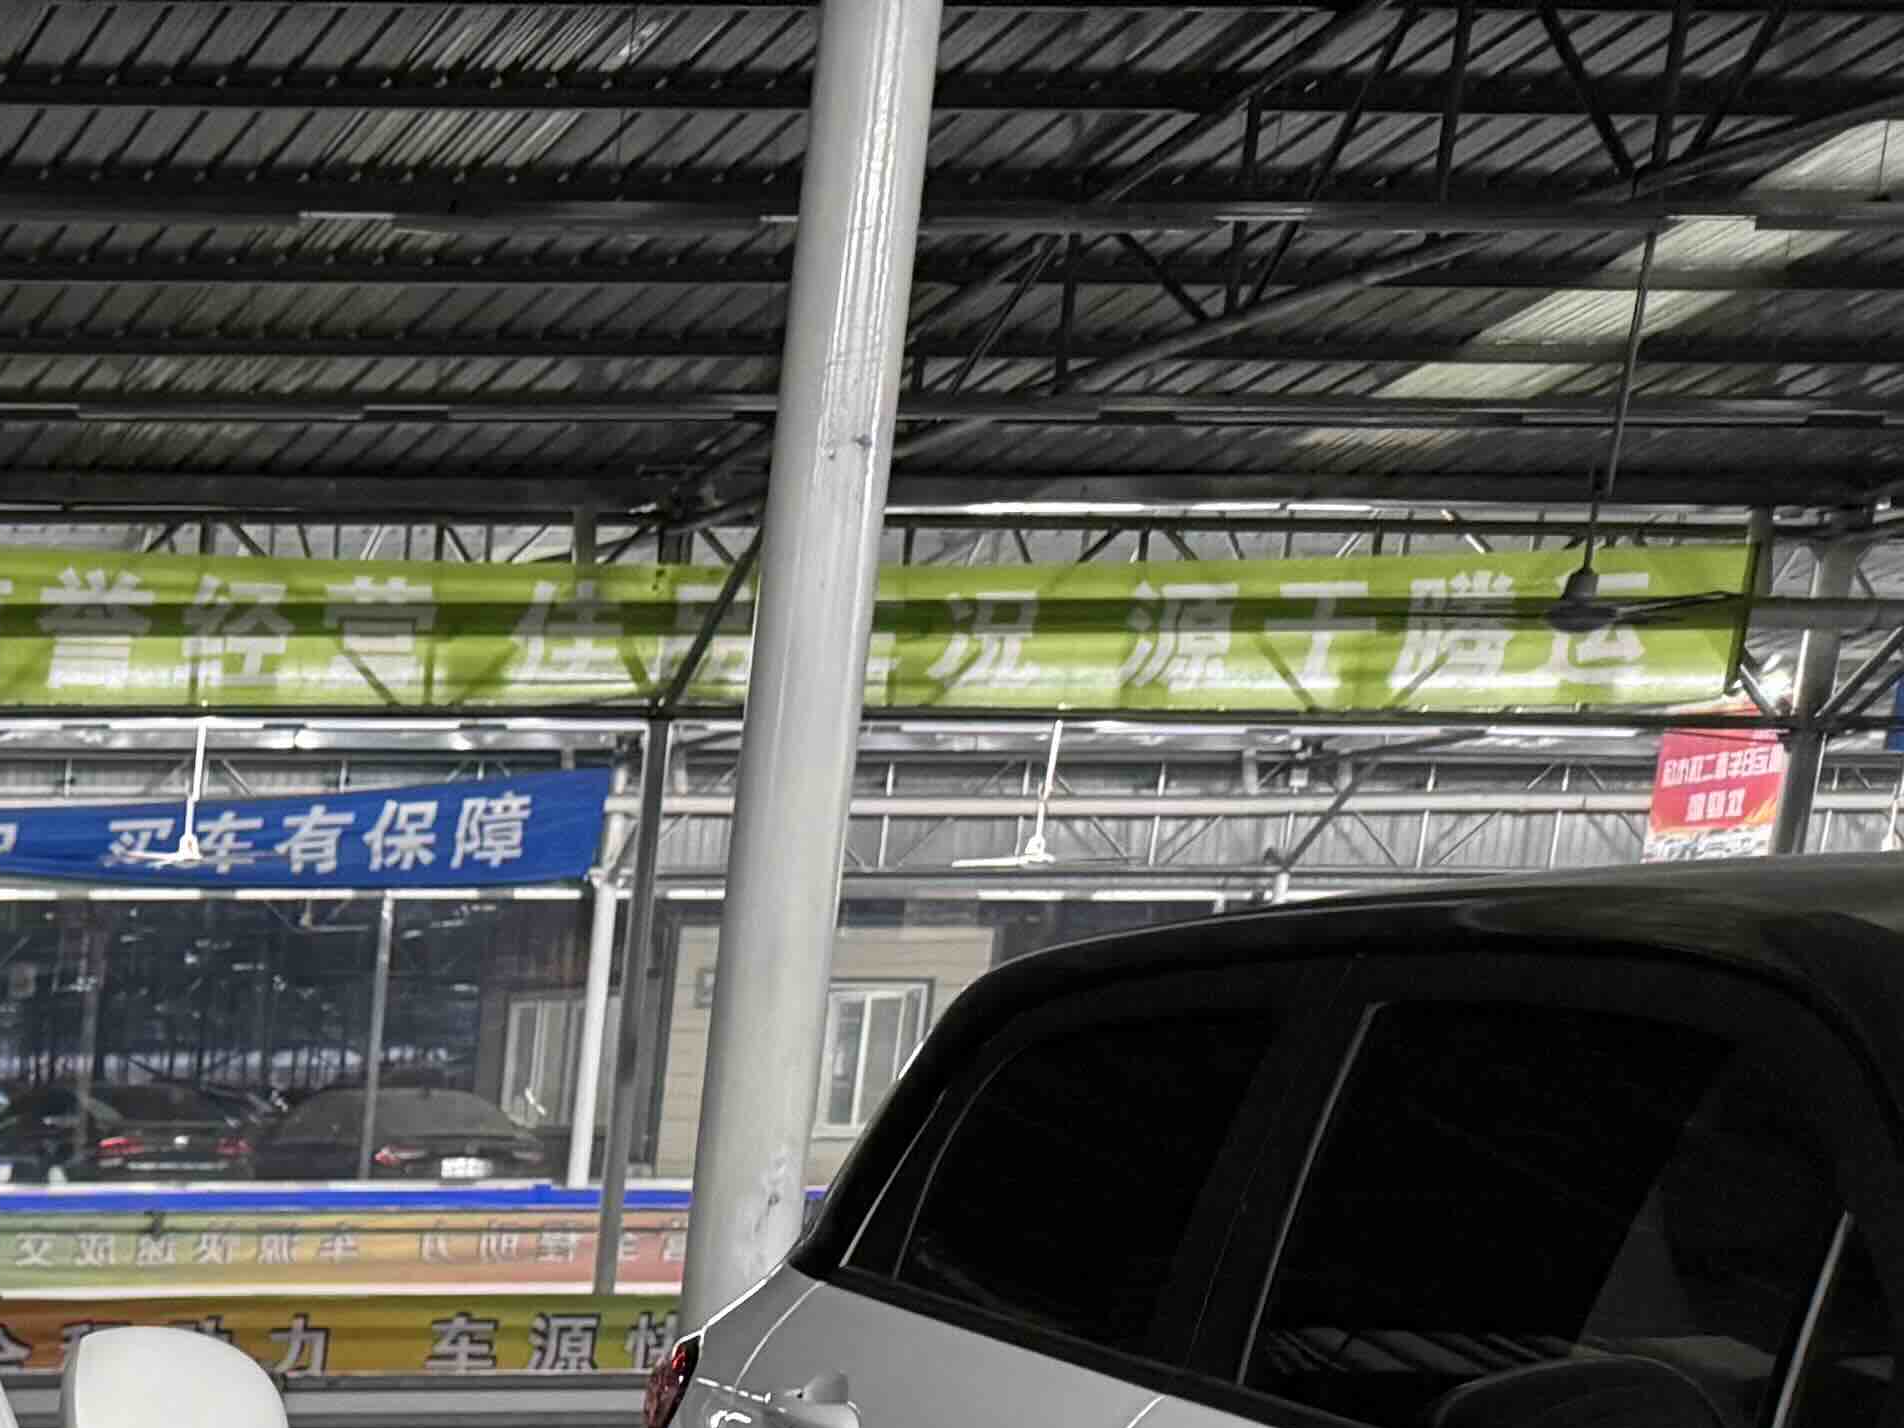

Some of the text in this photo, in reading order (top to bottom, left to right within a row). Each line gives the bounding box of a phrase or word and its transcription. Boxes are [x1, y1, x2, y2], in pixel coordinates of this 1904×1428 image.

[507, 576, 1040, 689] 佳品况
[102, 792, 531, 873] 买车有保障
